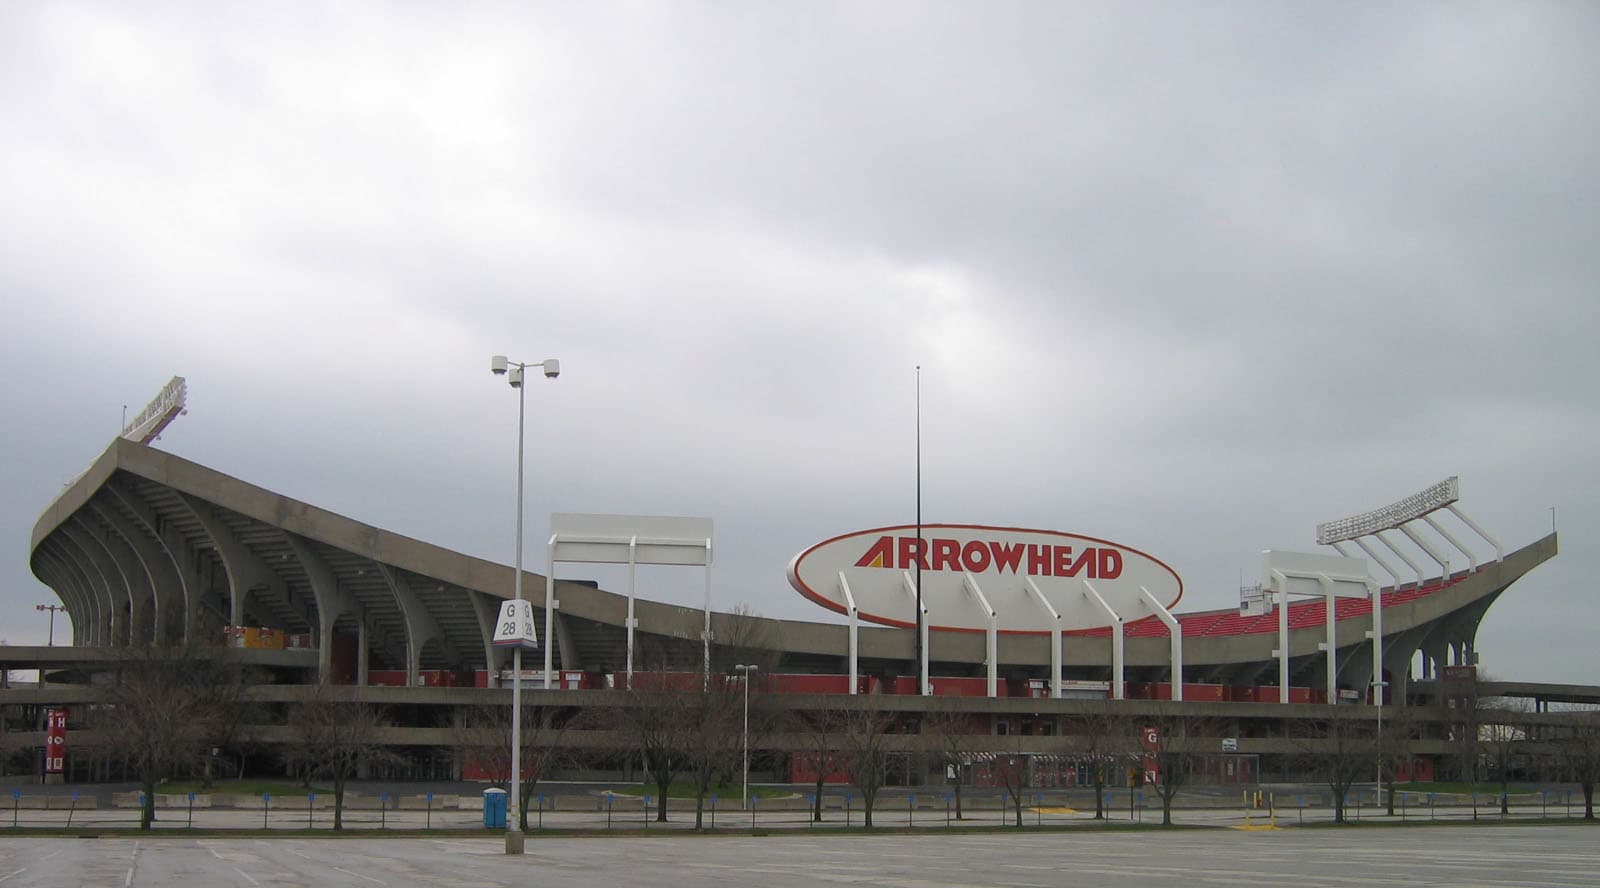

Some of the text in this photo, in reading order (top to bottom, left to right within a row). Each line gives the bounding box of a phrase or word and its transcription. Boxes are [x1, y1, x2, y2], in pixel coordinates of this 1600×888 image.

[854, 535, 1123, 580] ARROWHEAD
[506, 604, 516, 618] G
[502, 622, 516, 636] 28
[58, 717, 66, 728] H
[1148, 733, 1157, 743] G
